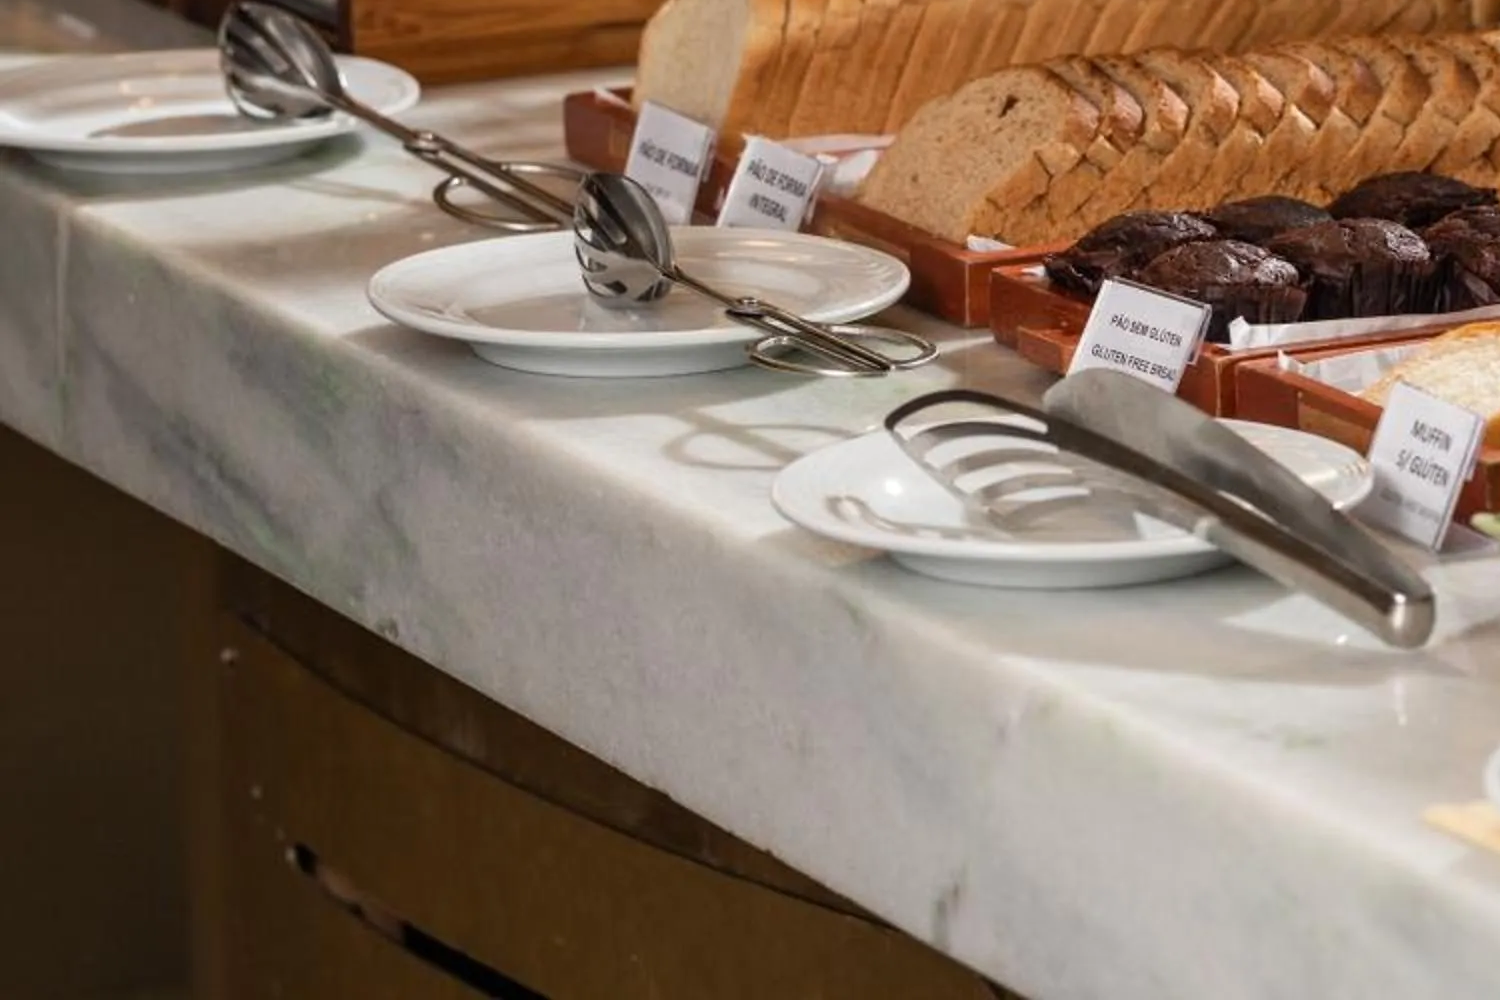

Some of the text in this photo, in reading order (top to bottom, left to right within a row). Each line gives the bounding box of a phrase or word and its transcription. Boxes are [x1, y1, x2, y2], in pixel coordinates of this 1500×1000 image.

[667, 152, 699, 178] FORMA
[747, 158, 767, 181] PÃO
[778, 173, 807, 198] FORMA
[749, 192, 787, 223] INTEGRAL
[1109, 311, 1129, 331] PÃO
[1129, 319, 1149, 338] SEM
[1091, 343, 1127, 365] GLUTEN
[1127, 354, 1151, 374] FREE
[1410, 419, 1452, 451] MUFFIN
